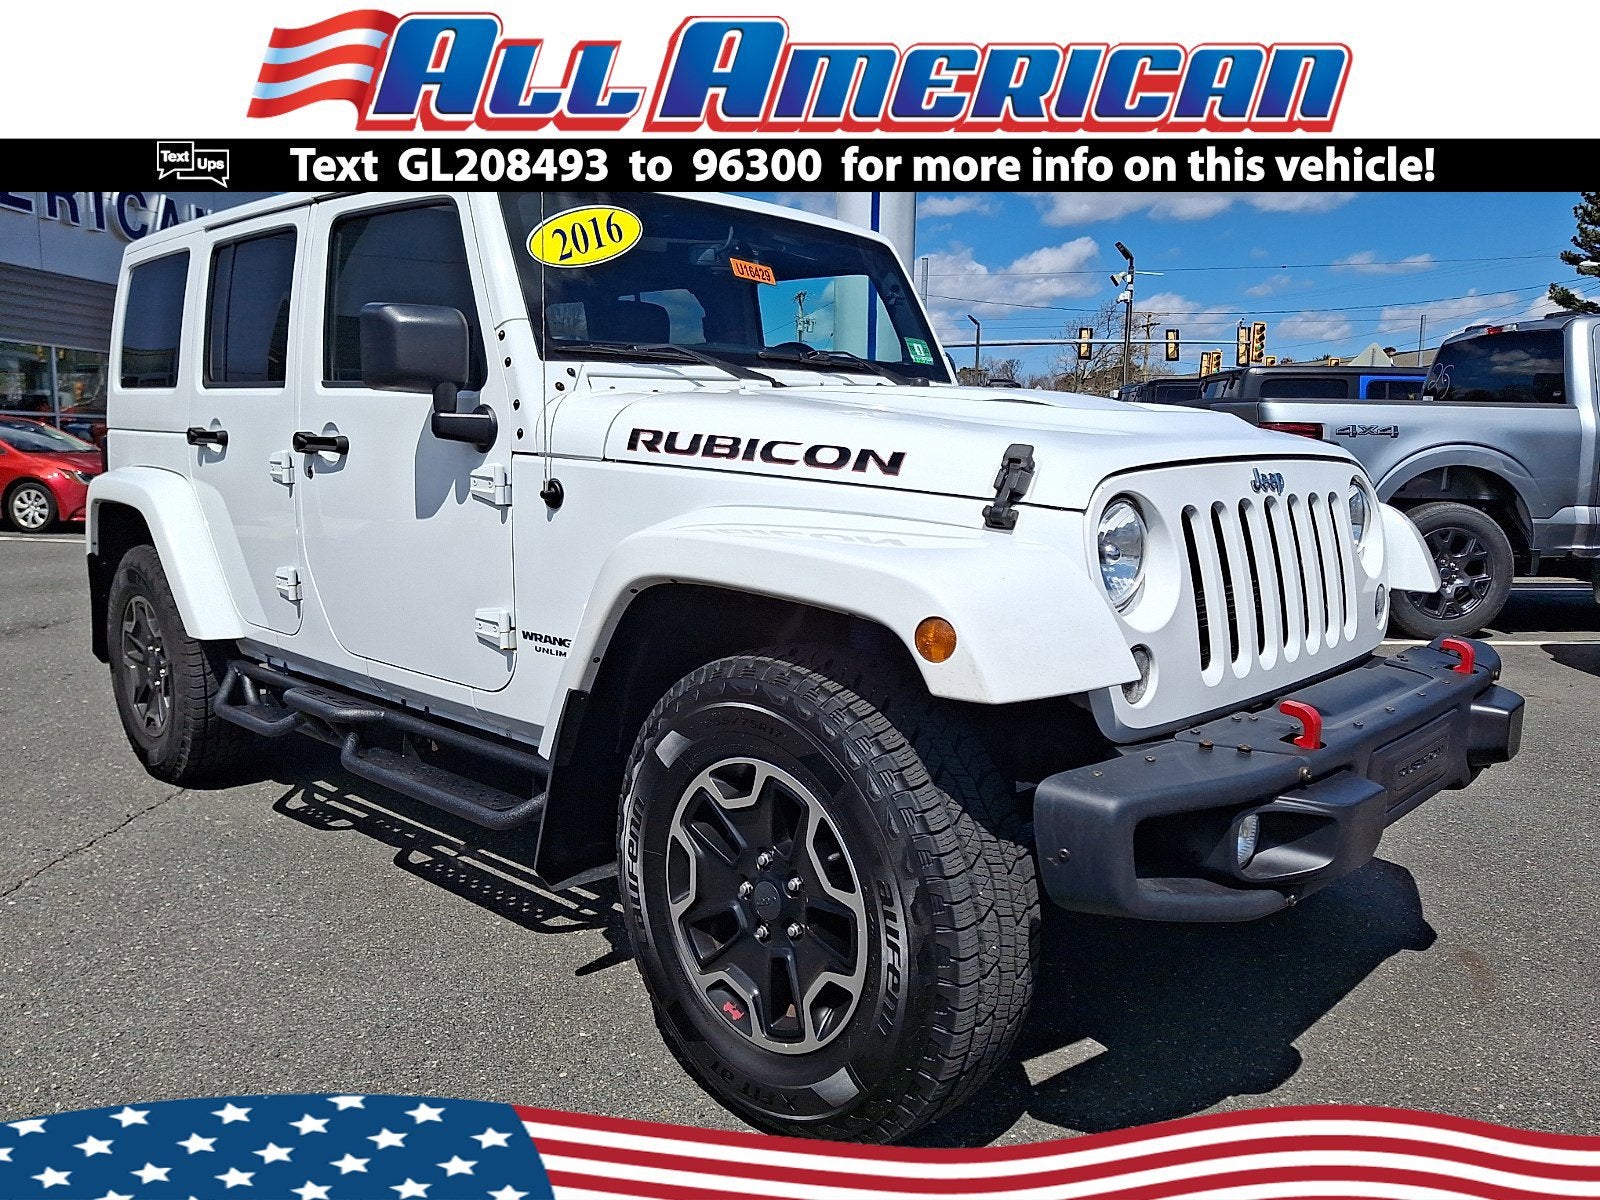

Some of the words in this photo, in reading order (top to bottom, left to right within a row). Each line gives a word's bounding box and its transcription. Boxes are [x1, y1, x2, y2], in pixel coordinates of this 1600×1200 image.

[552, 211, 623, 261] 2016
[734, 262, 772, 282] U16429
[1336, 424, 1399, 438] 4x4
[626, 427, 908, 477] RUBICON
[1250, 467, 1285, 497] Jeep
